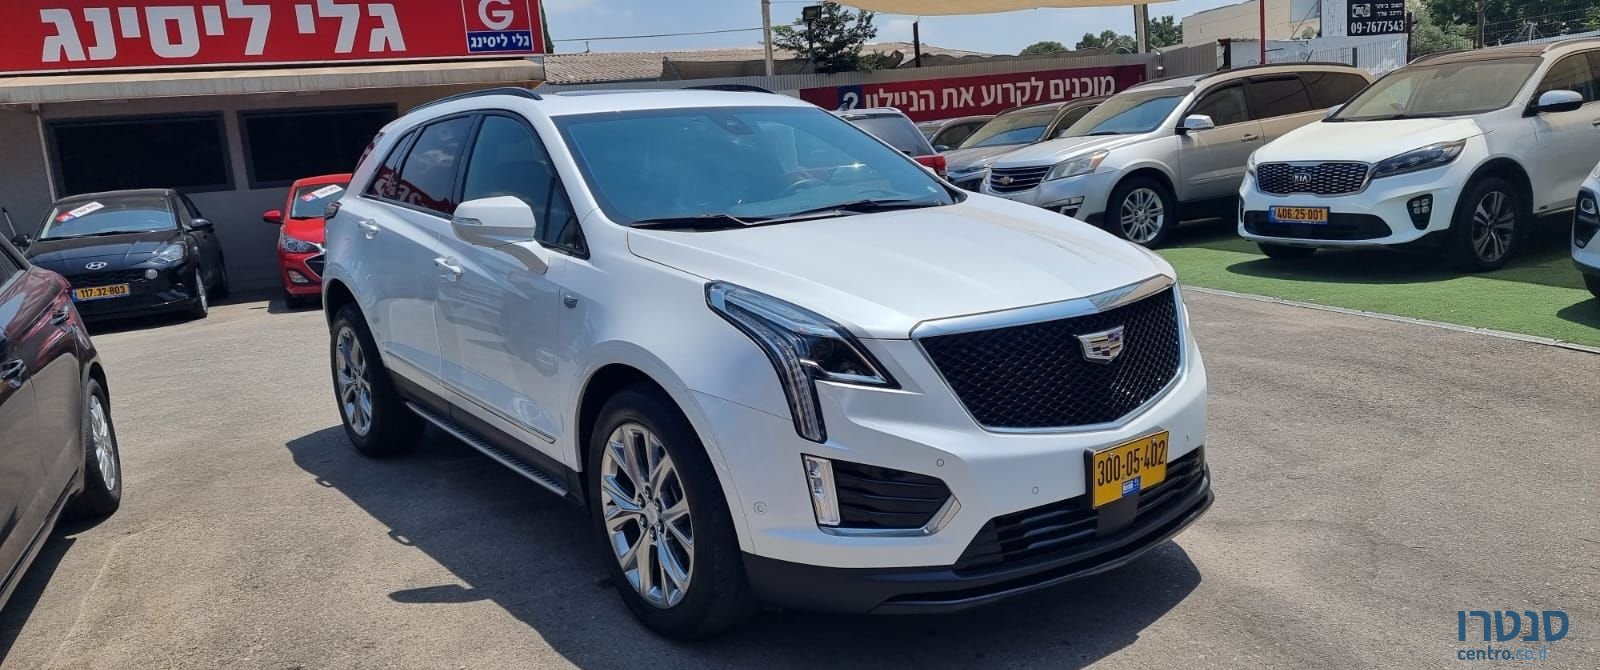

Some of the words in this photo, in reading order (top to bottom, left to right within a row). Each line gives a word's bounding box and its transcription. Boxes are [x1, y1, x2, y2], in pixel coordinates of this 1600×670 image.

[295, 0, 408, 54] גלי
[478, 0, 514, 30] G
[1350, 20, 1404, 34] 09-7677543
[39, 0, 272, 63] ליסינג
[470, 33, 508, 49] ליסינג
[511, 33, 530, 47] גלי
[941, 86, 976, 110] את
[981, 76, 1045, 108] לקרוע
[1049, 75, 1116, 100] מוכנים
[1293, 174, 1310, 183] KIA
